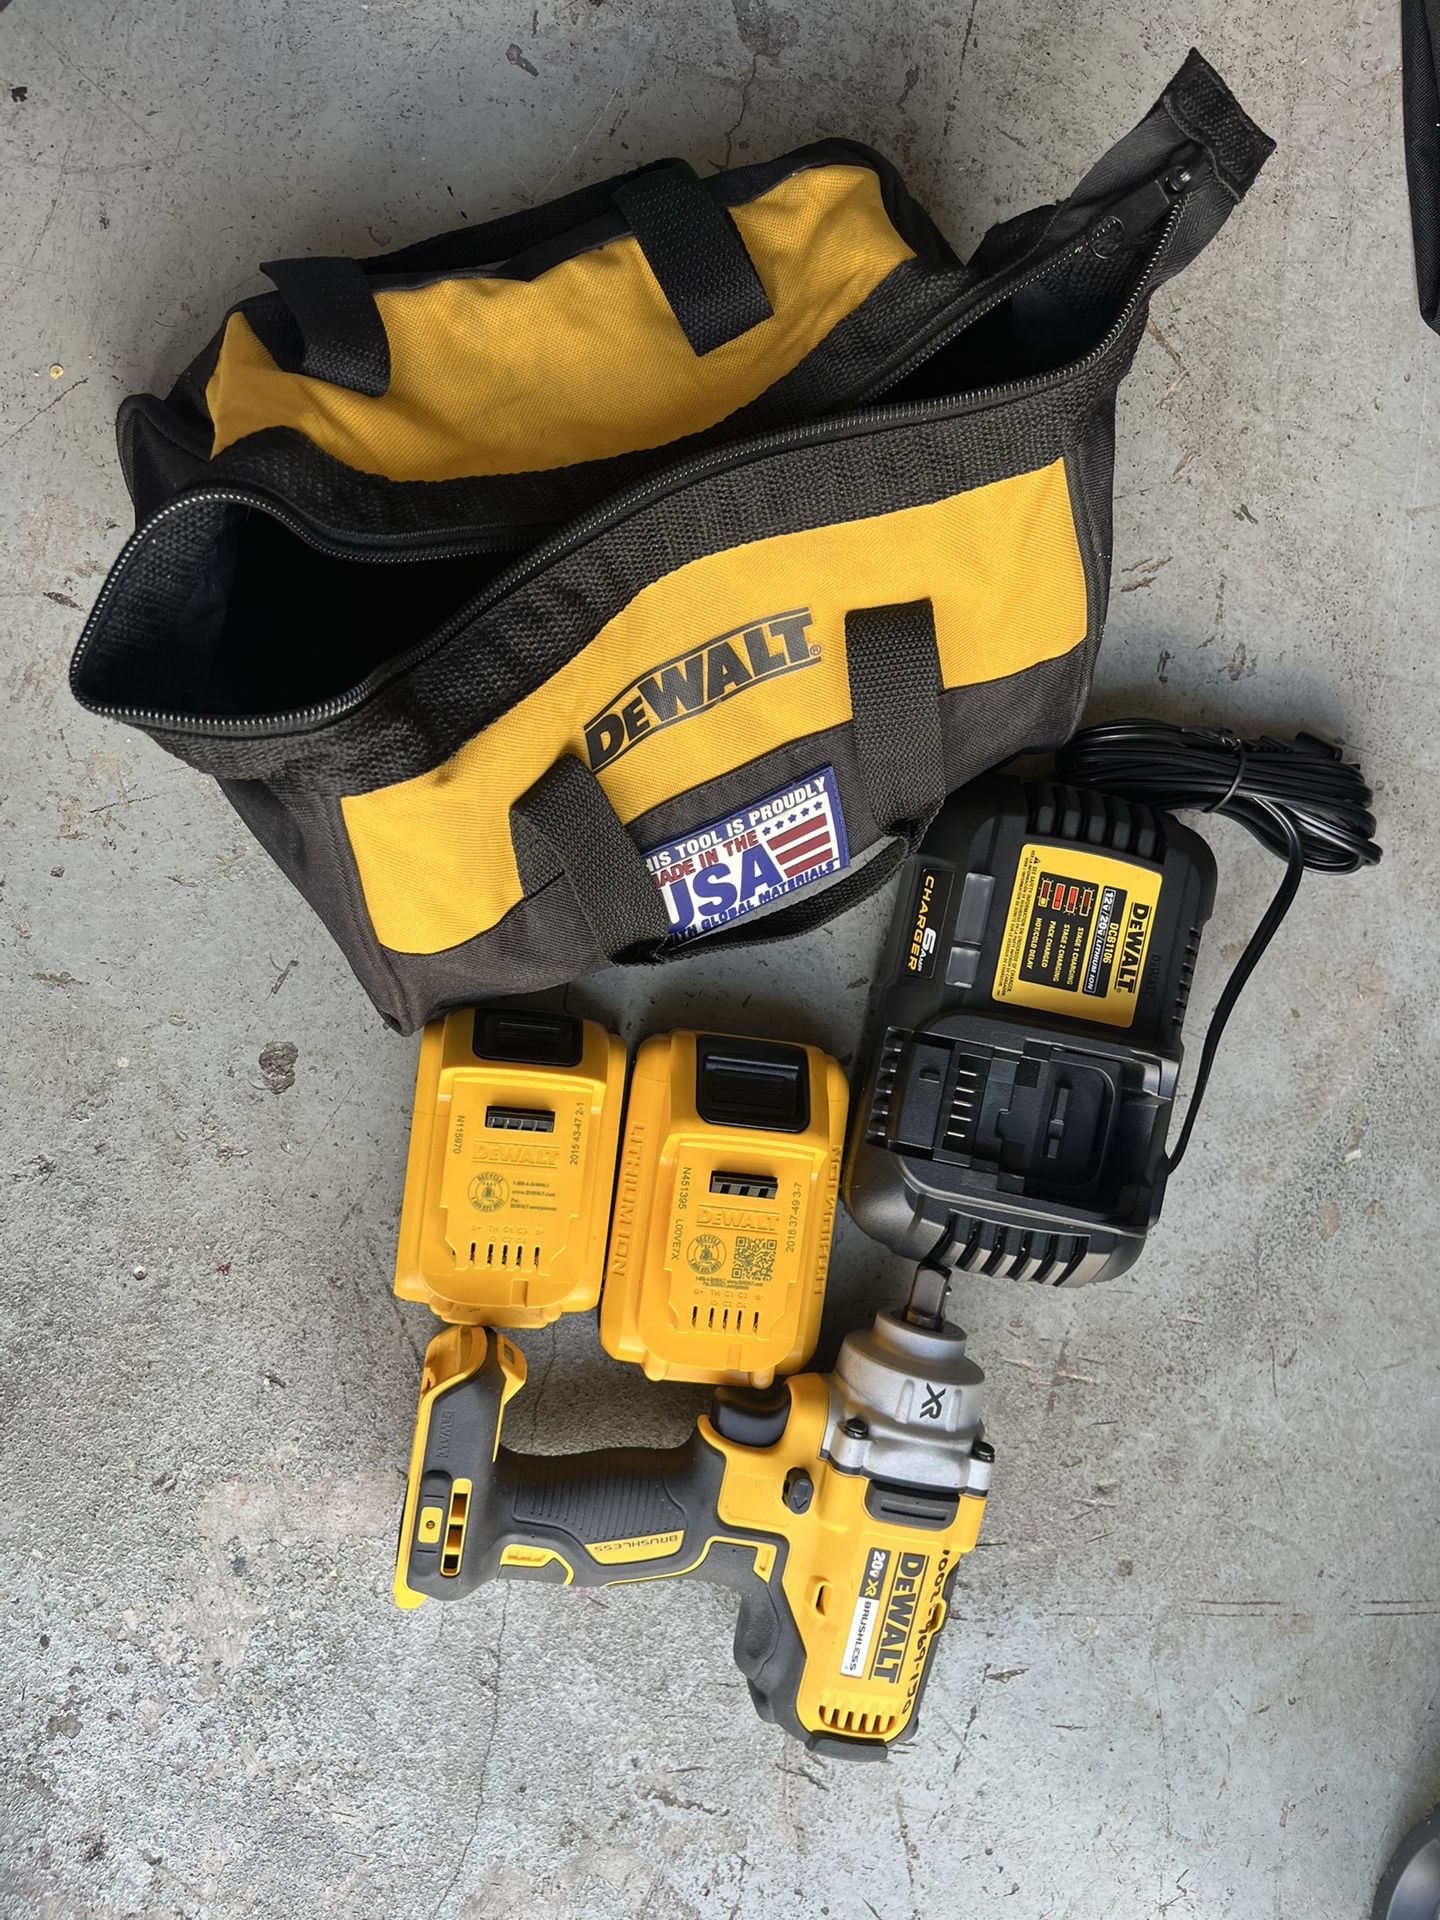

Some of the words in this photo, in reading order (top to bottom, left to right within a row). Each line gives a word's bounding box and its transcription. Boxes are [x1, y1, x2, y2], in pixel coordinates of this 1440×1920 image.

[647, 847, 672, 876] HIS
[675, 831, 722, 865] TOOL
[727, 817, 745, 838] IS
[749, 776, 827, 827] PROUDLY
[698, 849, 719, 868] IN
[723, 830, 759, 857] THE
[669, 923, 698, 948] ITH
[700, 899, 755, 931] GLOBAL
[758, 860, 836, 905] MATERIALS
[1021, 894, 1031, 927] INFORMATION
[908, 874, 935, 972] CHARGER
[1030, 917, 1042, 948] HOT/COLD
[1047, 920, 1056, 937] PACK
[1060, 924, 1070, 944] STAGE
[1074, 927, 1084, 947] STAGE
[1026, 949, 1035, 969] DELAY
[1041, 938, 1053, 968] CHARGED
[1102, 922, 1119, 964] DCB1106
[1116, 902, 1150, 993] DEWALT
[1052, 949, 1065, 982] CHARGING
[1066, 952, 1079, 985] CHARGING
[1086, 974, 1095, 990] ION
[575, 1102, 584, 1116] 2-1
[453, 1115, 465, 1155] N115970
[572, 1118, 583, 1142] 43-47
[569, 1144, 580, 1165] 2015
[620, 1124, 644, 1225] LITHIUM
[678, 1167, 691, 1210] N451395
[792, 1182, 803, 1198] 3-7
[788, 1199, 801, 1227] 37-49
[614, 1233, 633, 1277] ION
[785, 1229, 797, 1253] 2018
[920, 1383, 946, 1420] XR
[594, 1534, 679, 1552] BRUSHLESS
[864, 1580, 880, 1598] XR
[876, 1554, 926, 1683] DEWALT
[848, 1601, 872, 1672] BRUSHLESS
